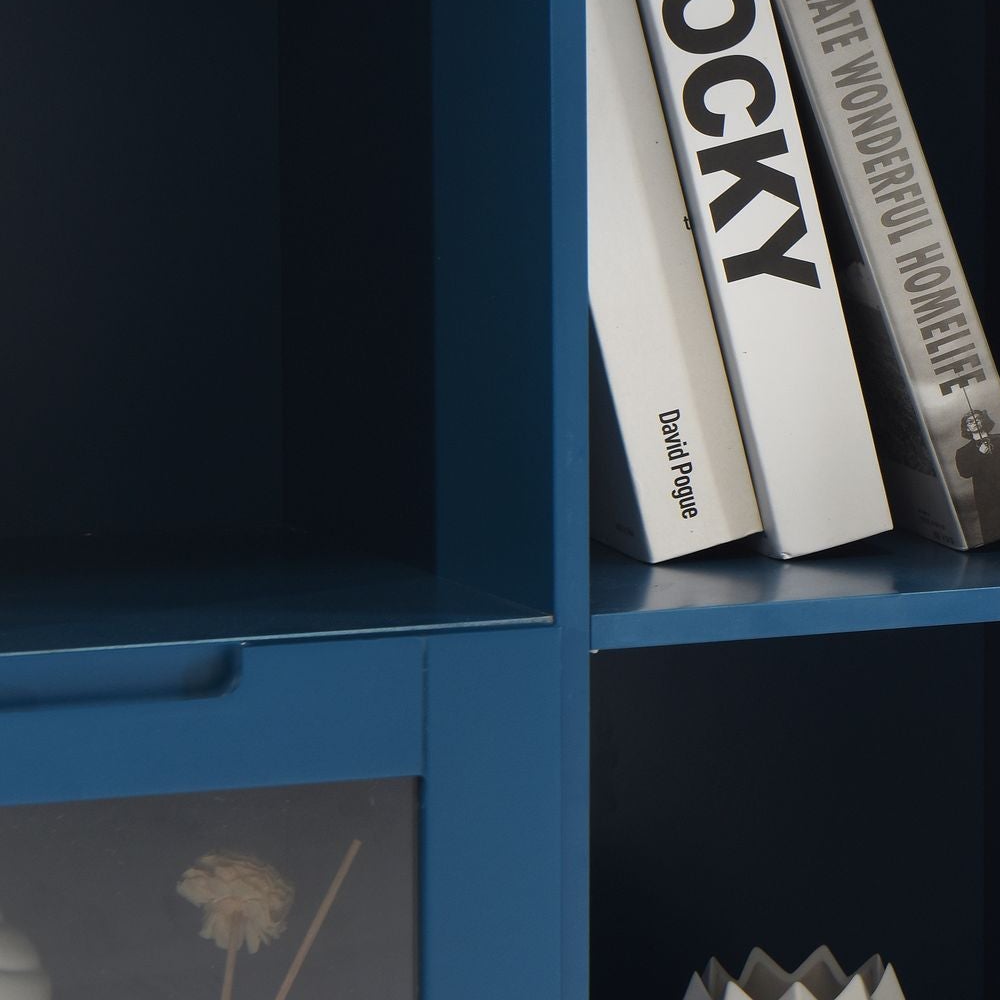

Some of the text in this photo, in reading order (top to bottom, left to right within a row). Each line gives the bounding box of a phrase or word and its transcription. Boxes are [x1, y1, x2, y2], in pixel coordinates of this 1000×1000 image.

[830, 49, 932, 246] WONDERFUL
[895, 241, 987, 397] HOMELIFE
[658, 409, 698, 519] David Pogue
